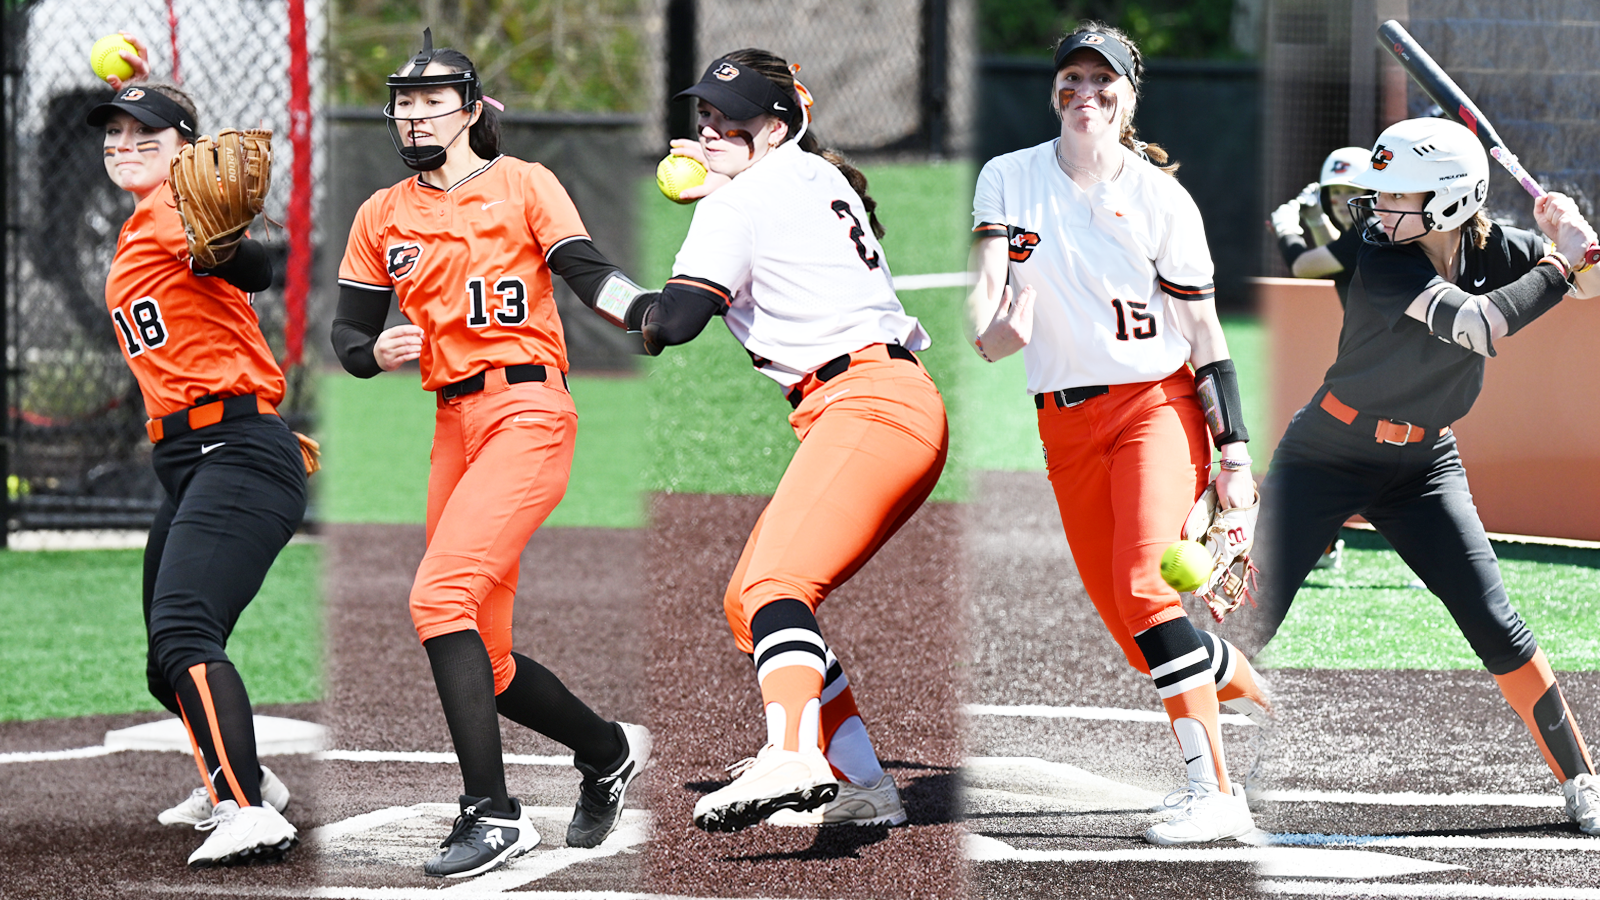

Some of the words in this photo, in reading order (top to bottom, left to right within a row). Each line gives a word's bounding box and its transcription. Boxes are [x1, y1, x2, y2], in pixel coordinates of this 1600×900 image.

[226, 147, 237, 183] A2000
[831, 200, 880, 271] 2
[112, 296, 169, 358] 18
[466, 276, 529, 328] 13
[1111, 298, 1157, 341] 15
